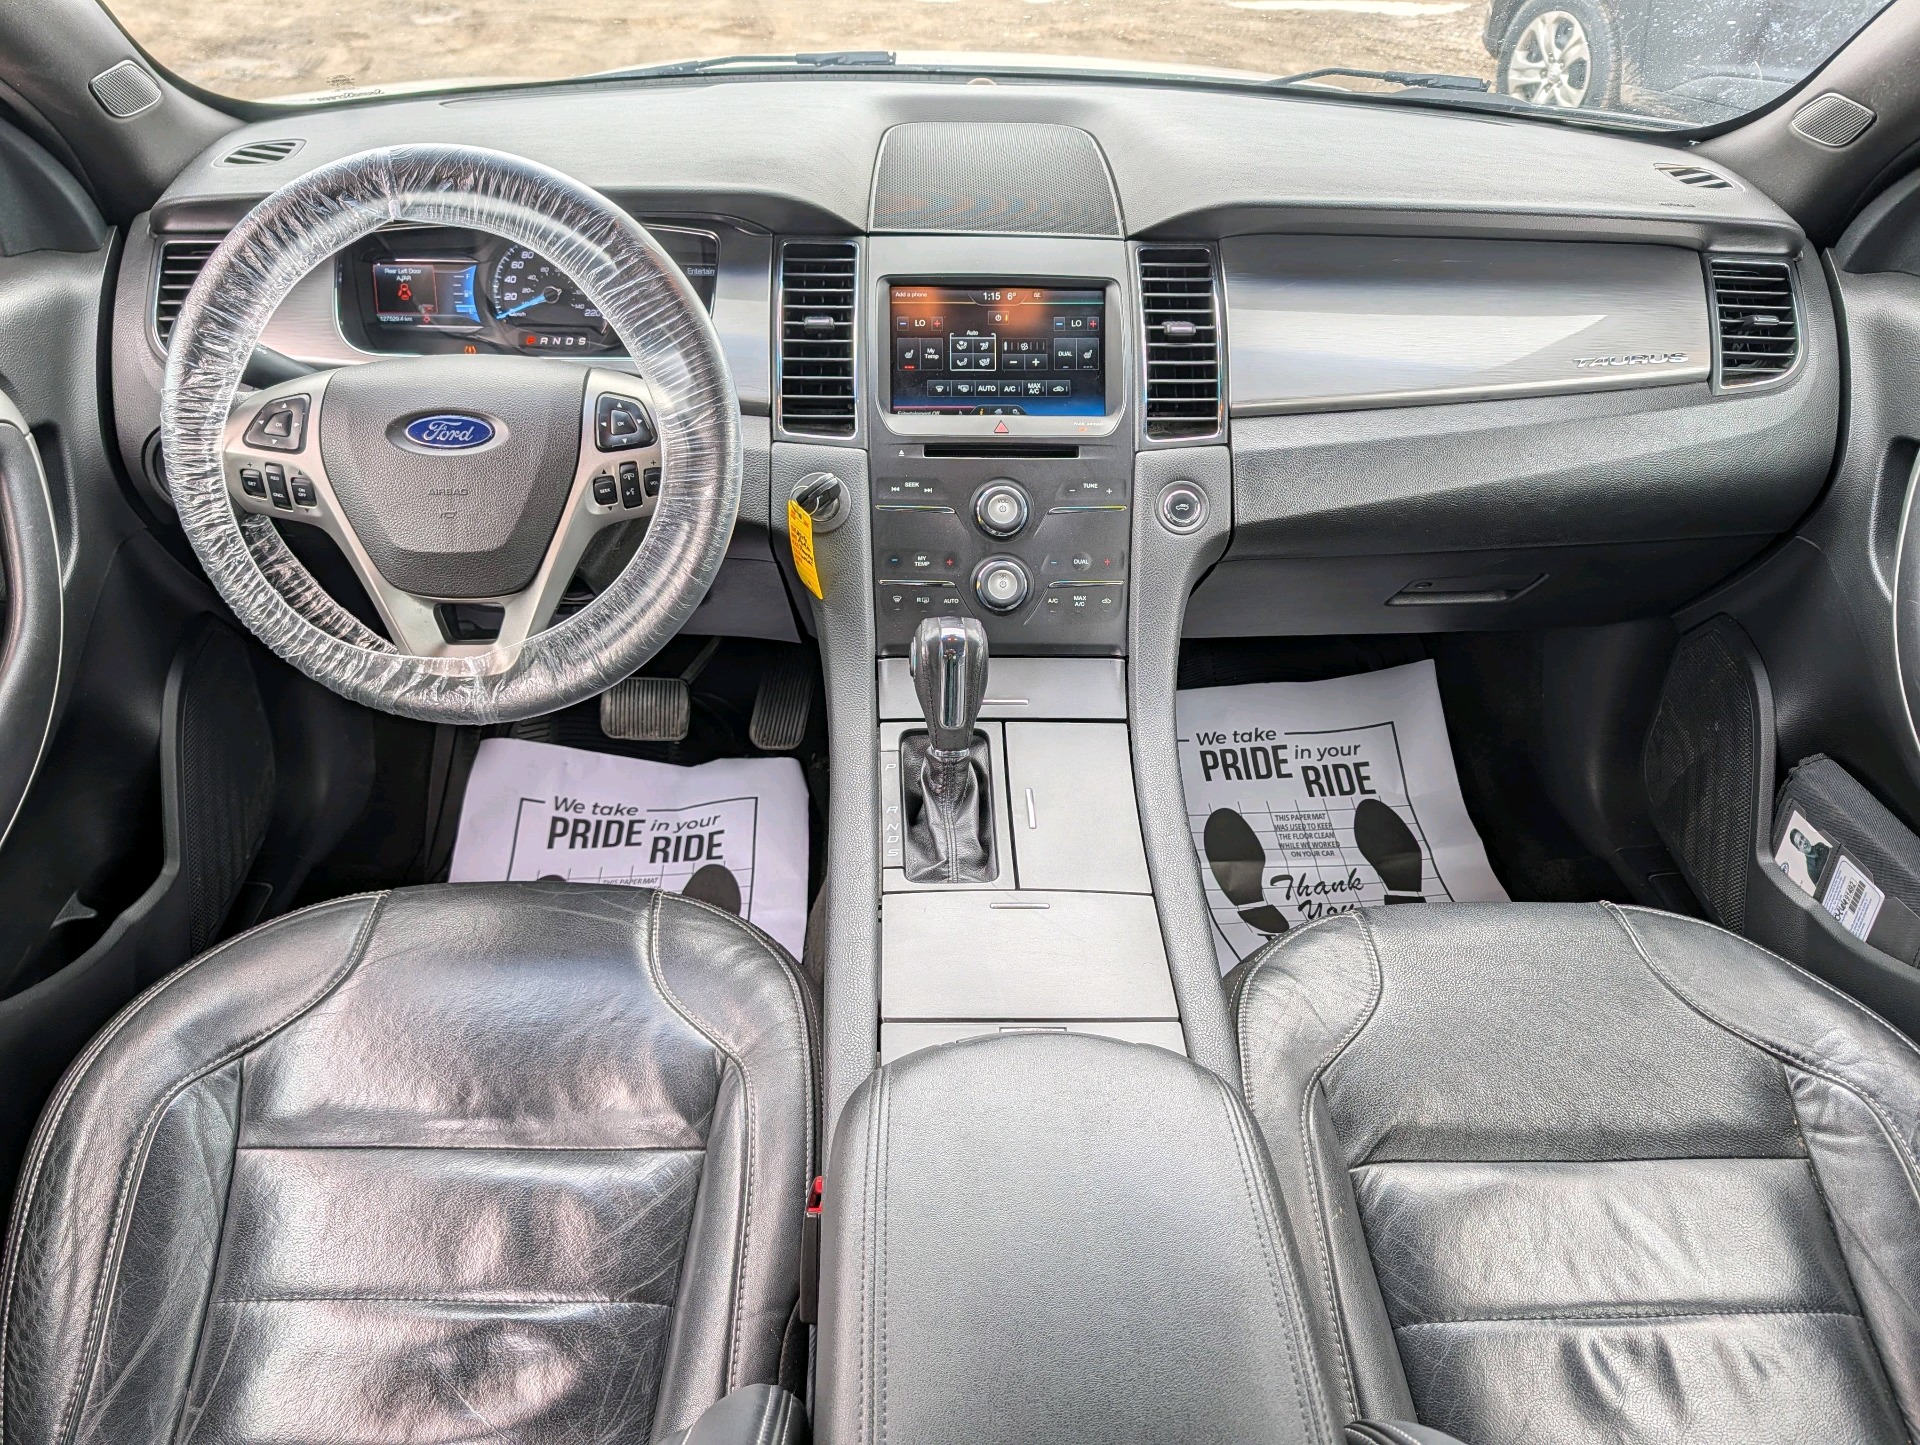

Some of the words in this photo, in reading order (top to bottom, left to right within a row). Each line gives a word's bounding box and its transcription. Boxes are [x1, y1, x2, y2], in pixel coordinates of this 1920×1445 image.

[521, 251, 534, 259] 80
[511, 261, 524, 269] 60
[983, 292, 1001, 300] 1:15
[584, 309, 600, 317] 220
[914, 319, 926, 327] LO
[1071, 319, 1082, 327] LO
[1573, 352, 1689, 368] TAURUS
[1003, 385, 1016, 393] A/C
[422, 420, 475, 442] Ford
[428, 488, 469, 496] AIRBAG
[1196, 730, 1227, 746] We
[1233, 727, 1277, 743] take
[1294, 744, 1312, 760] in
[1317, 743, 1361, 762] your
[1199, 744, 1294, 782] PRIDE
[1301, 761, 1377, 798] RIDE
[554, 795, 586, 814] We
[592, 803, 639, 817] take
[1291, 813, 1312, 821] PAPER
[1311, 812, 1326, 820] MAT
[650, 819, 670, 832] in
[673, 815, 721, 833] your
[886, 823, 899, 831] N
[1290, 823, 1307, 831] USED
[1317, 822, 1333, 830] KEEP
[547, 816, 646, 850] PRIDE
[1292, 832, 1313, 840] FLOOR
[1314, 831, 1335, 839] CLEAN
[887, 836, 899, 844] D
[649, 829, 725, 864] RIDE
[1300, 841, 1311, 849] WE
[1312, 841, 1340, 849] WORKED
[887, 849, 900, 857] S
[1269, 867, 1364, 901] Thank
